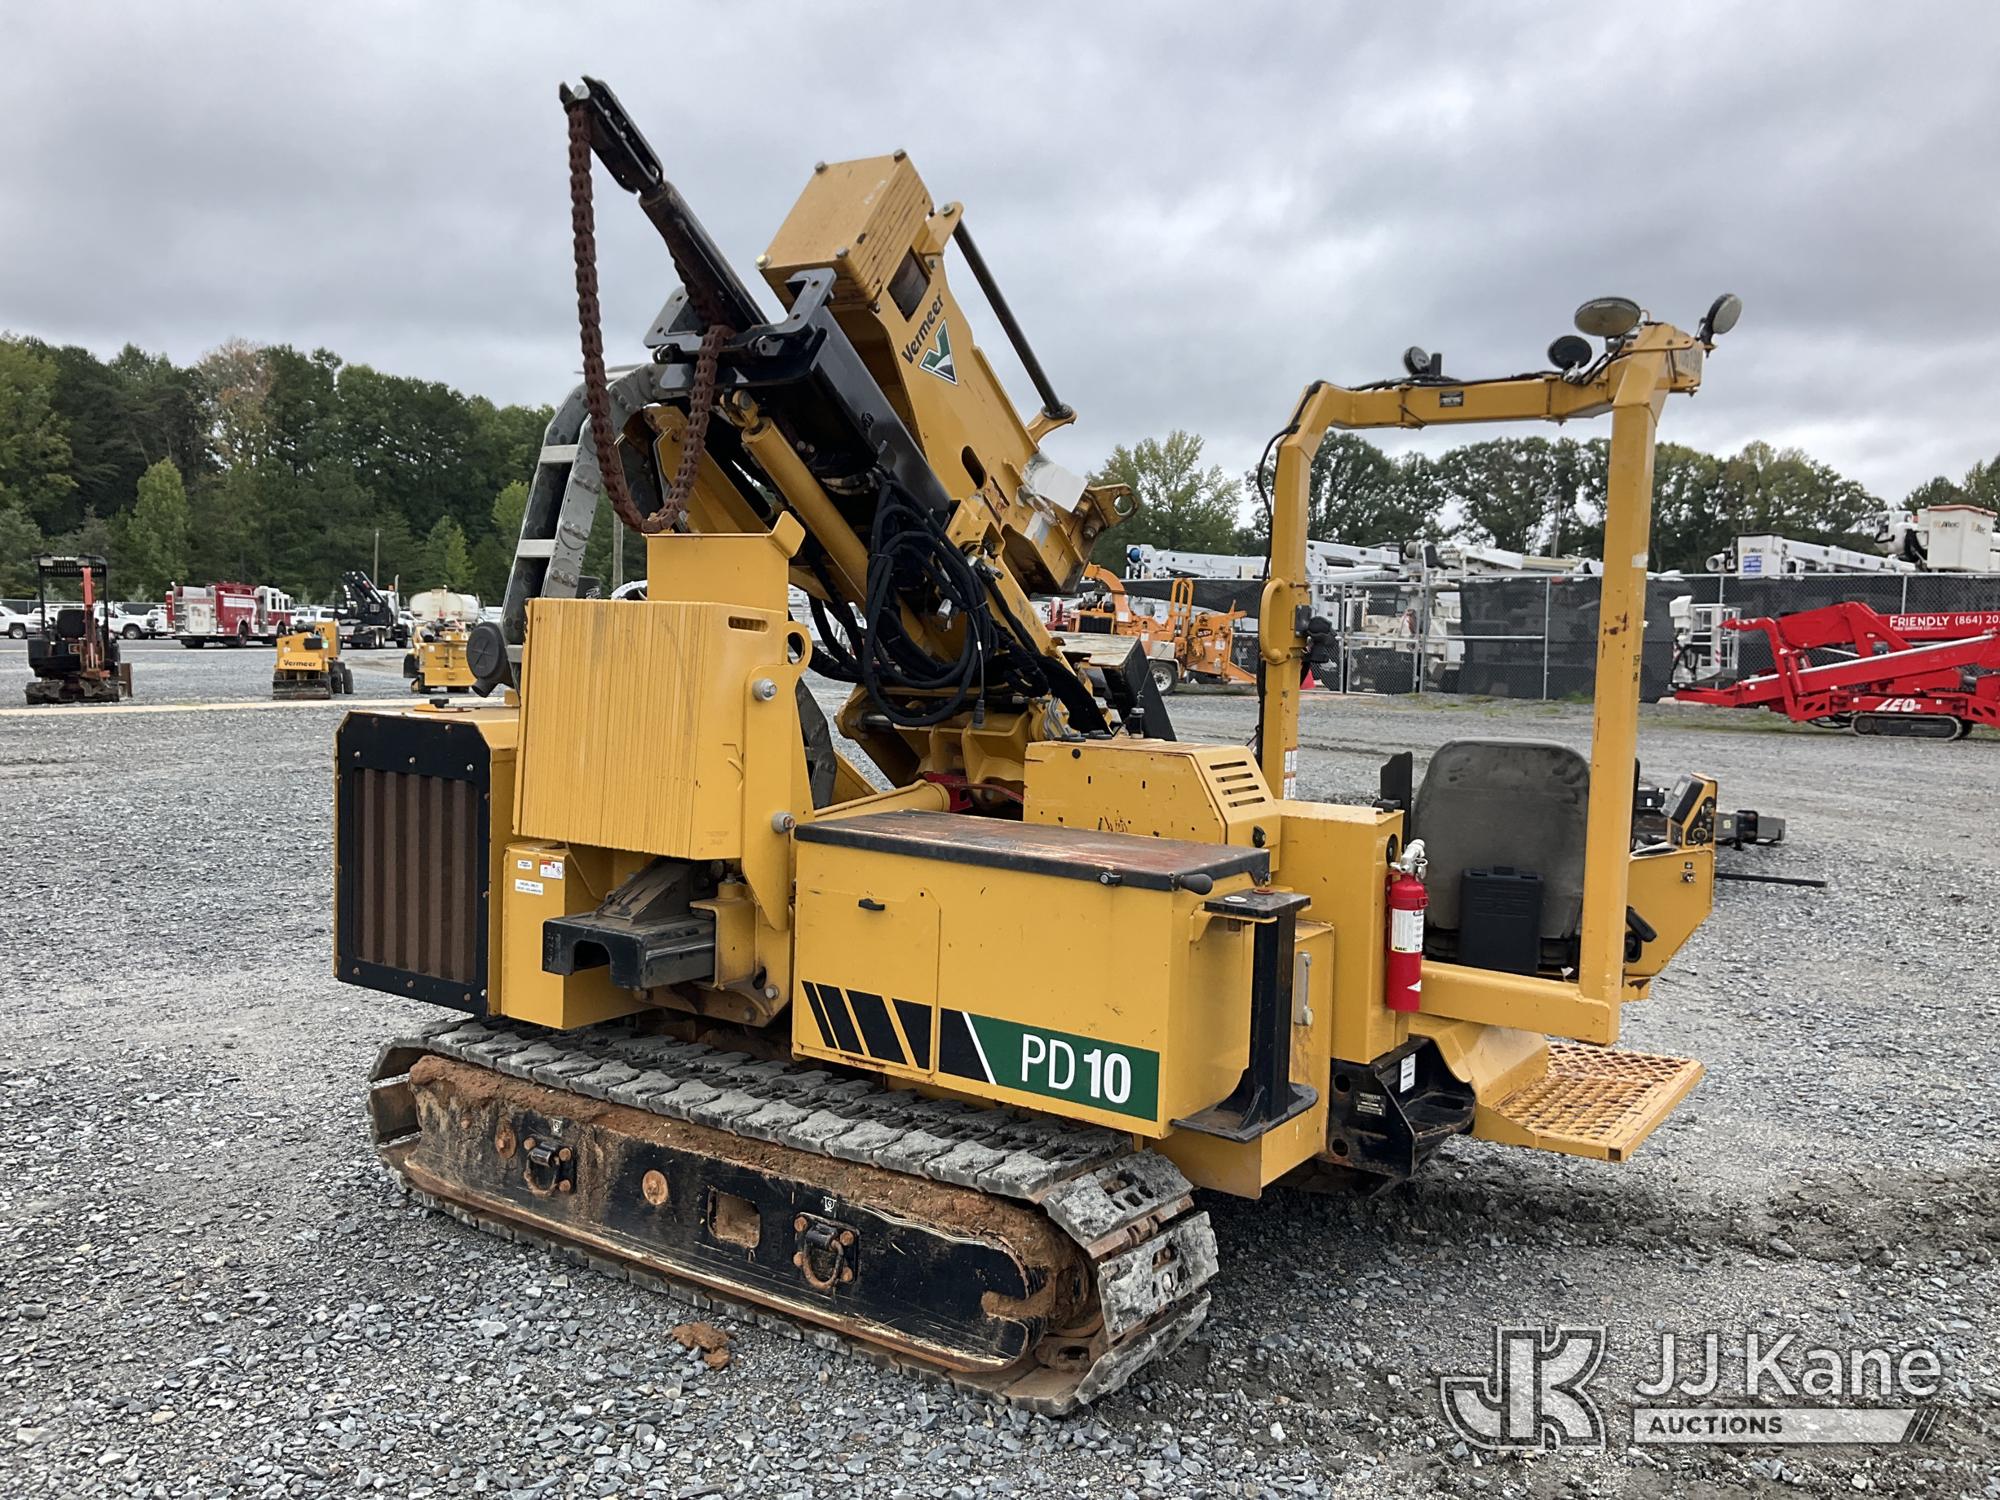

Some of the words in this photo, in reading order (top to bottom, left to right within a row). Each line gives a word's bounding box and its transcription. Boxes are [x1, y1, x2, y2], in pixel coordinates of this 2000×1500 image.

[901, 294, 943, 364] Vermeer
[1889, 615, 1950, 628] FRIENDLY
[1955, 615, 1982, 626] (864)
[1986, 615, 2000, 624] 20
[283, 659, 316, 667] Vermeer
